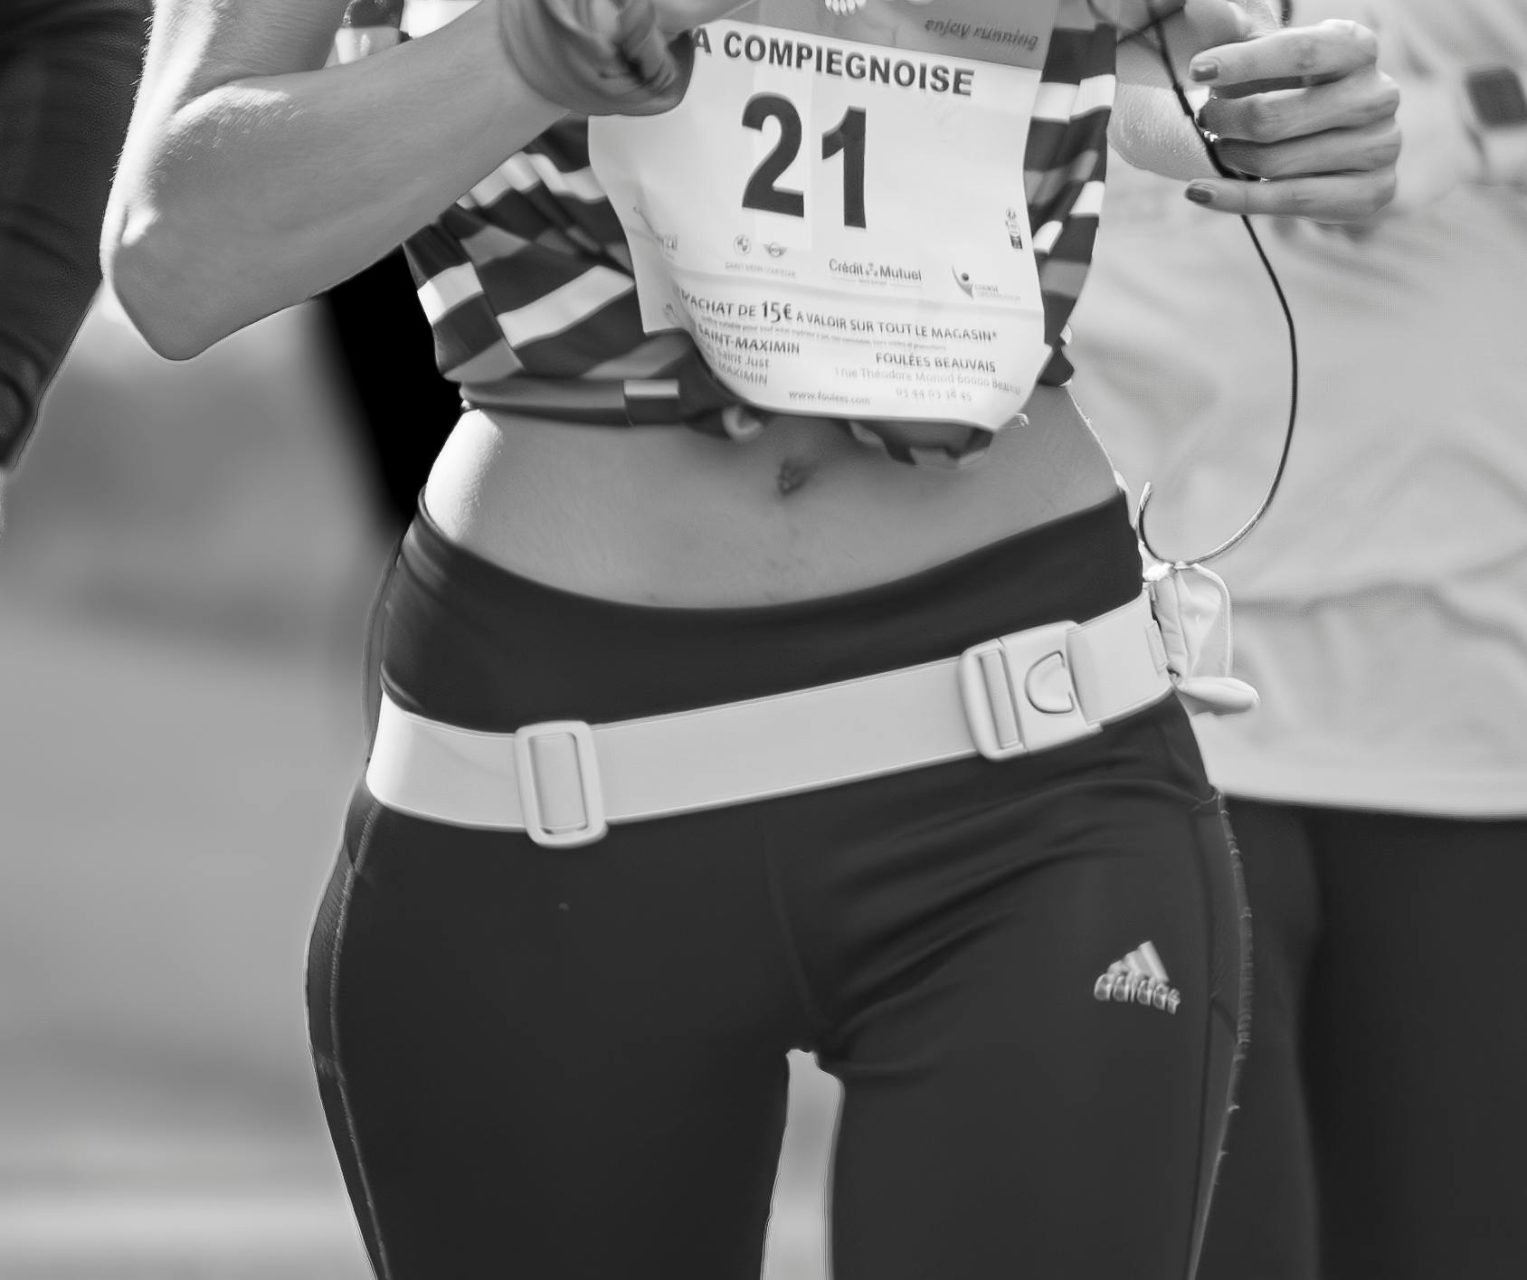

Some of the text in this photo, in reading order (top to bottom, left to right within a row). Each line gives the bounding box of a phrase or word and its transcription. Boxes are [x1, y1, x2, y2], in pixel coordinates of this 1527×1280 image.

[723, 30, 976, 97] COMPIEGNOISE
[741, 91, 867, 230] 21
[880, 265, 923, 282] Mutuel
[738, 303, 757, 318] DE
[761, 299, 793, 324] 15€
[806, 312, 848, 332] VALOIR
[849, 318, 875, 334] SUR
[877, 321, 913, 336] TOUT
[914, 324, 929, 338] LE
[934, 356, 997, 373] BEAUVAIS
